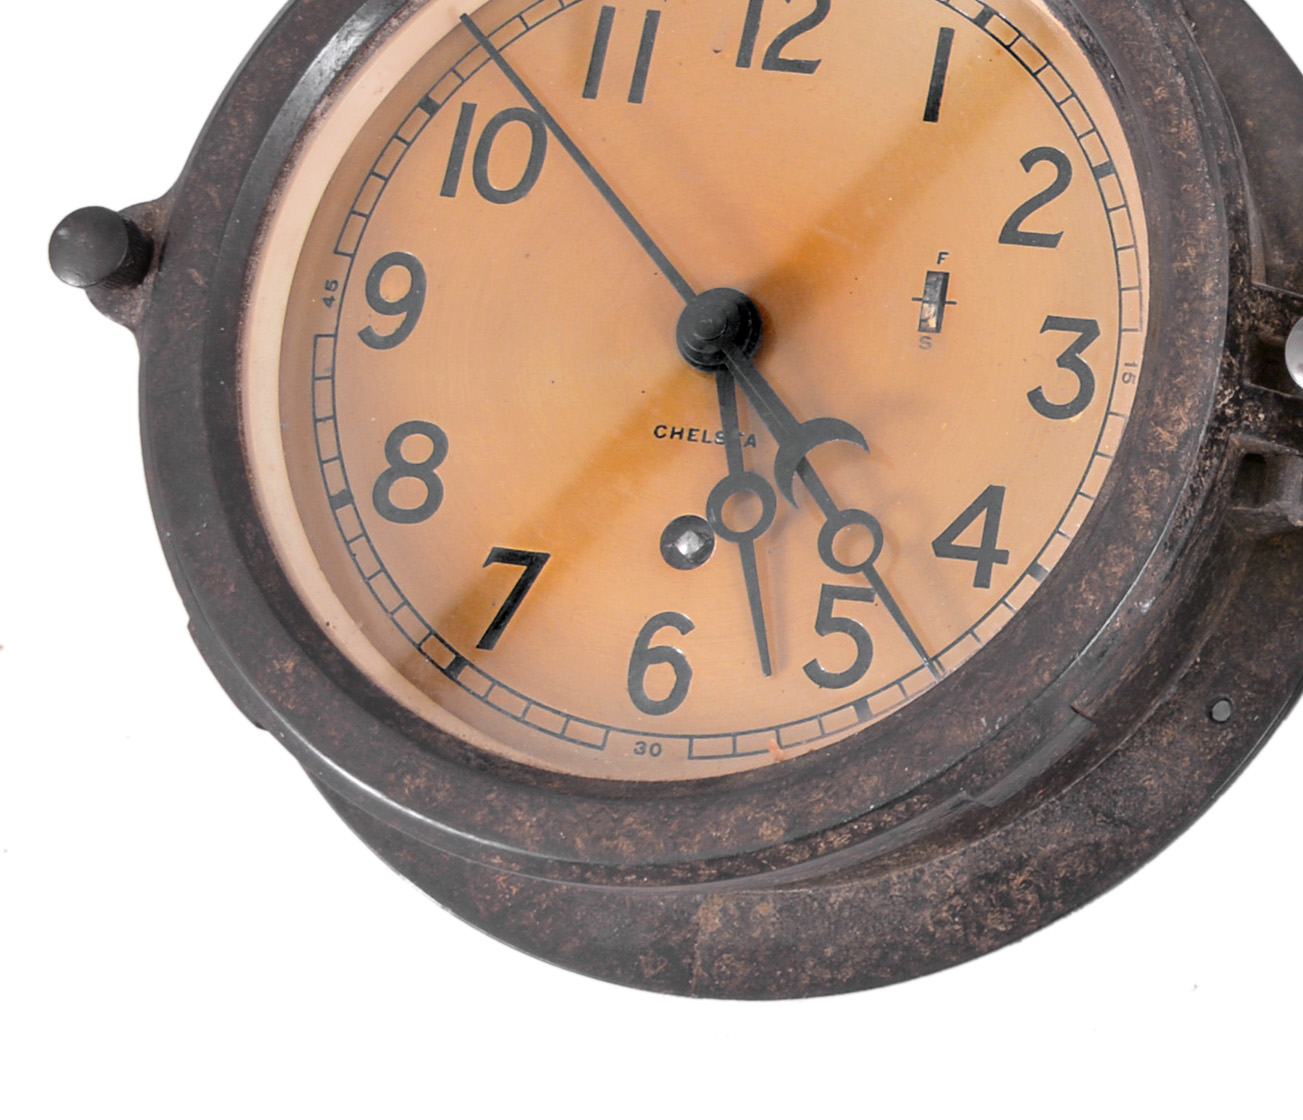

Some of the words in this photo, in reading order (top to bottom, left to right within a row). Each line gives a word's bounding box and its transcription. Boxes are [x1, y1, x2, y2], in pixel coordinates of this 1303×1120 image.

[582, 5, 661, 104] 11
[440, 101, 548, 205] 10
[937, 251, 949, 265] F
[322, 280, 339, 307] 45
[358, 251, 427, 350] 9
[918, 336, 932, 350] S
[1026, 315, 1101, 420] 3
[1121, 360, 1138, 385] 15
[653, 424, 757, 449] CHELSA
[627, 611, 696, 716] 6
[633, 741, 662, 758] 30
